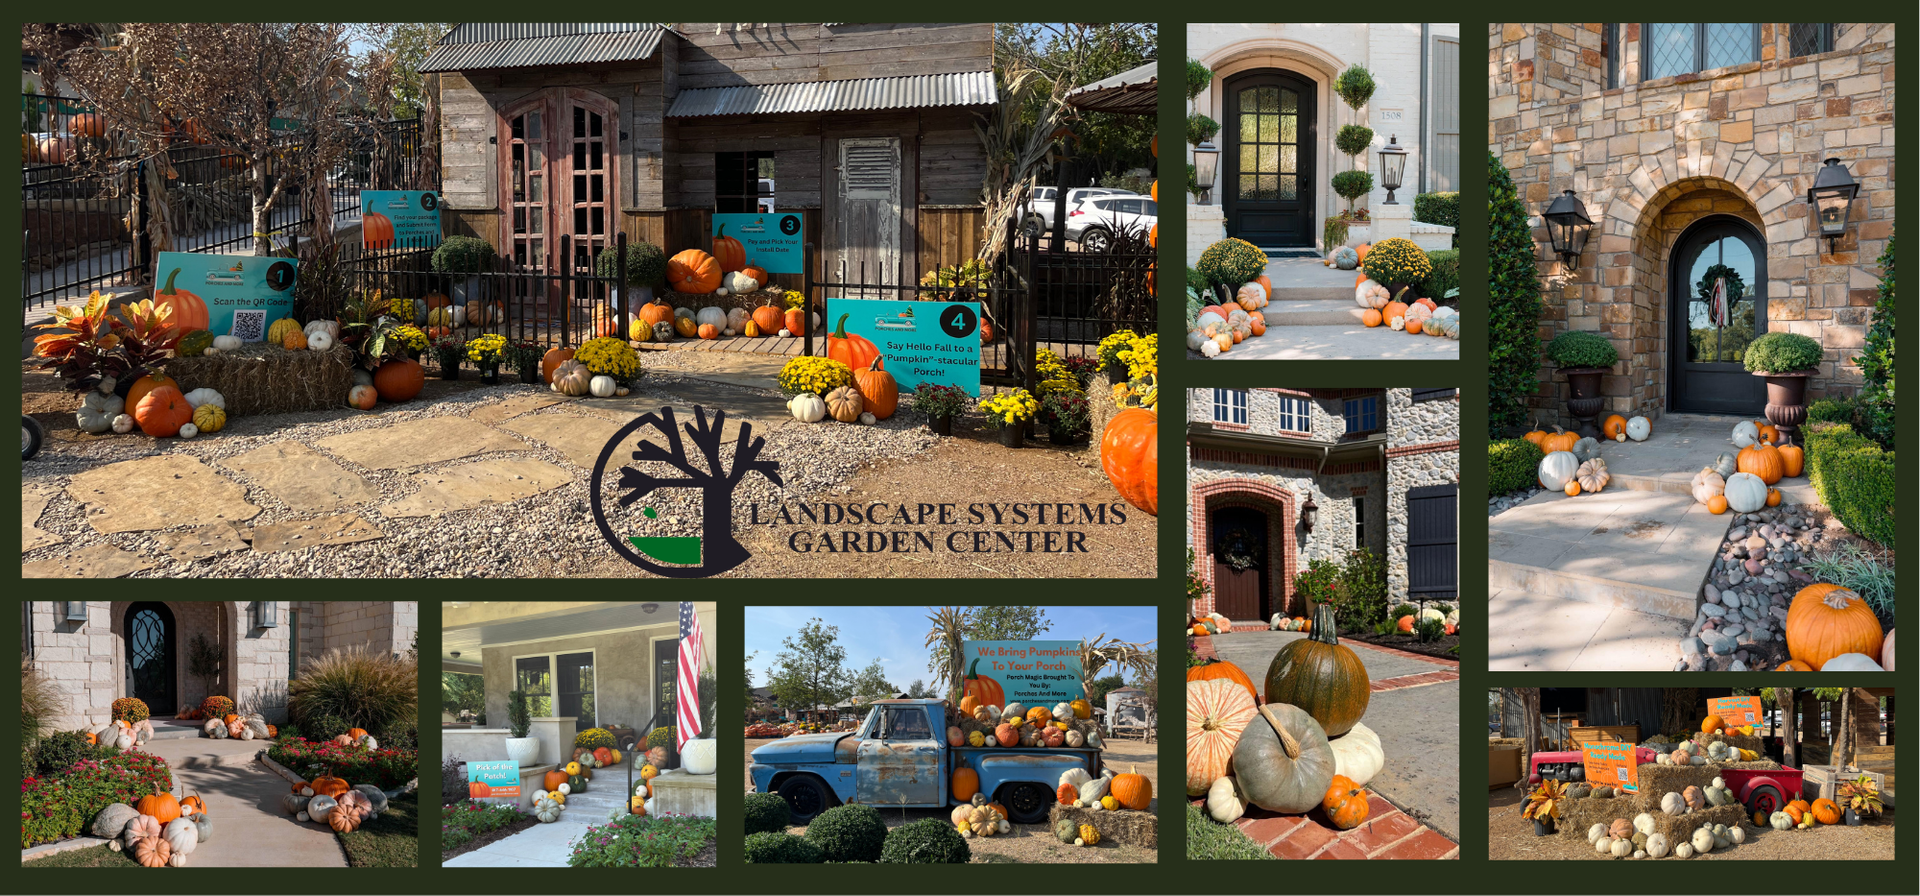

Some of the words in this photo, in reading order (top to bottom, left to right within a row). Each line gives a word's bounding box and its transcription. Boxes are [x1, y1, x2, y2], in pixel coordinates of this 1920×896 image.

[1381, 111, 1402, 120] 1508
[425, 197, 432, 207] 2
[786, 220, 794, 231] 3
[277, 269, 284, 283] 1
[213, 297, 235, 306] Scan
[237, 298, 252, 306] the
[253, 298, 266, 307] QR
[267, 298, 288, 306] Code
[951, 312, 966, 330] 4
[887, 341, 904, 352] Say
[906, 343, 932, 352] Hello
[934, 344, 952, 353] Fall
[954, 345, 965, 353] to
[913, 367, 945, 377] Porch!
[977, 646, 996, 656] We
[998, 646, 1026, 659] Bring
[1029, 646, 1081, 659] Pumpkins
[991, 661, 1005, 671] To
[1007, 661, 1034, 671] Your
[1036, 661, 1066, 671] Porch
[1584, 743, 1619, 751] Monochrome
[1590, 752, 1607, 761] Ready
[1608, 753, 1625, 761] Made
[484, 772, 506, 780] Patch!
